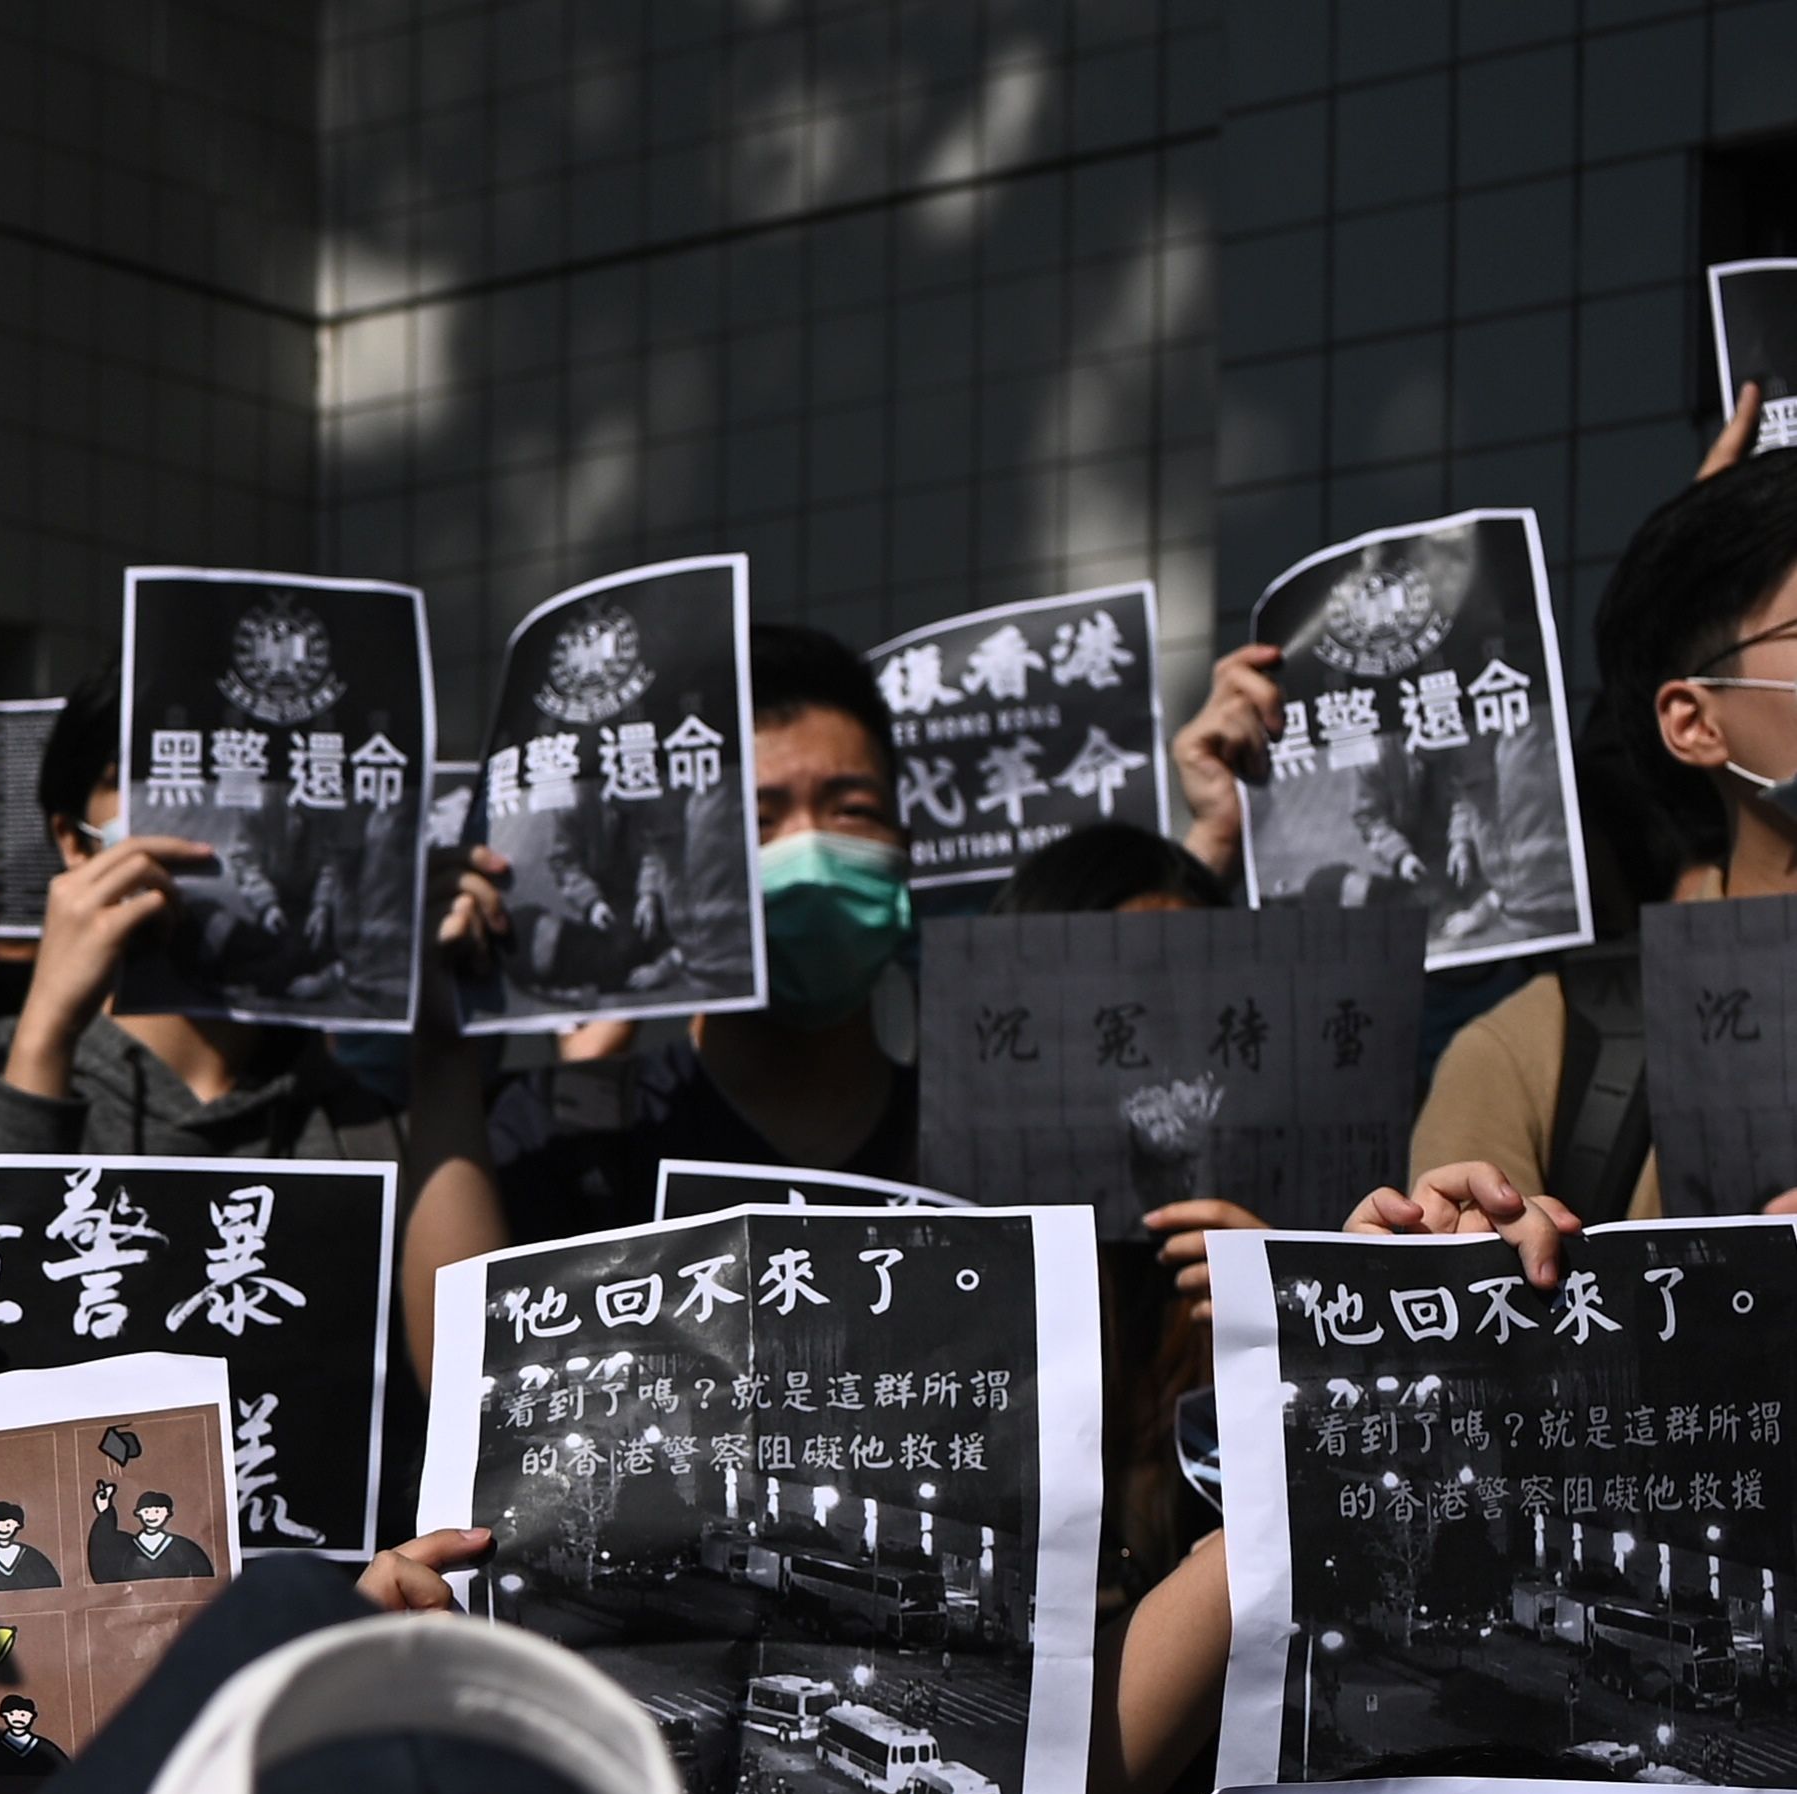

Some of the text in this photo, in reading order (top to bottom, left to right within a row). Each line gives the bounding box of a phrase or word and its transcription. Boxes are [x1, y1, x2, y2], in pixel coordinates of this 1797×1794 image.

[890, 718, 920, 748] EE
[1267, 657, 1533, 782] 黑警還命
[146, 727, 408, 811] 黑警還命
[486, 714, 724, 818] 黑警還命
[505, 1246, 980, 1344] 他回不來了。
[1302, 1265, 1755, 1348] 他回不來了。
[520, 1431, 989, 1477] 的香港警察阻礙他救援
[1339, 1469, 1767, 1522] 的香港警察阻礙他救援
